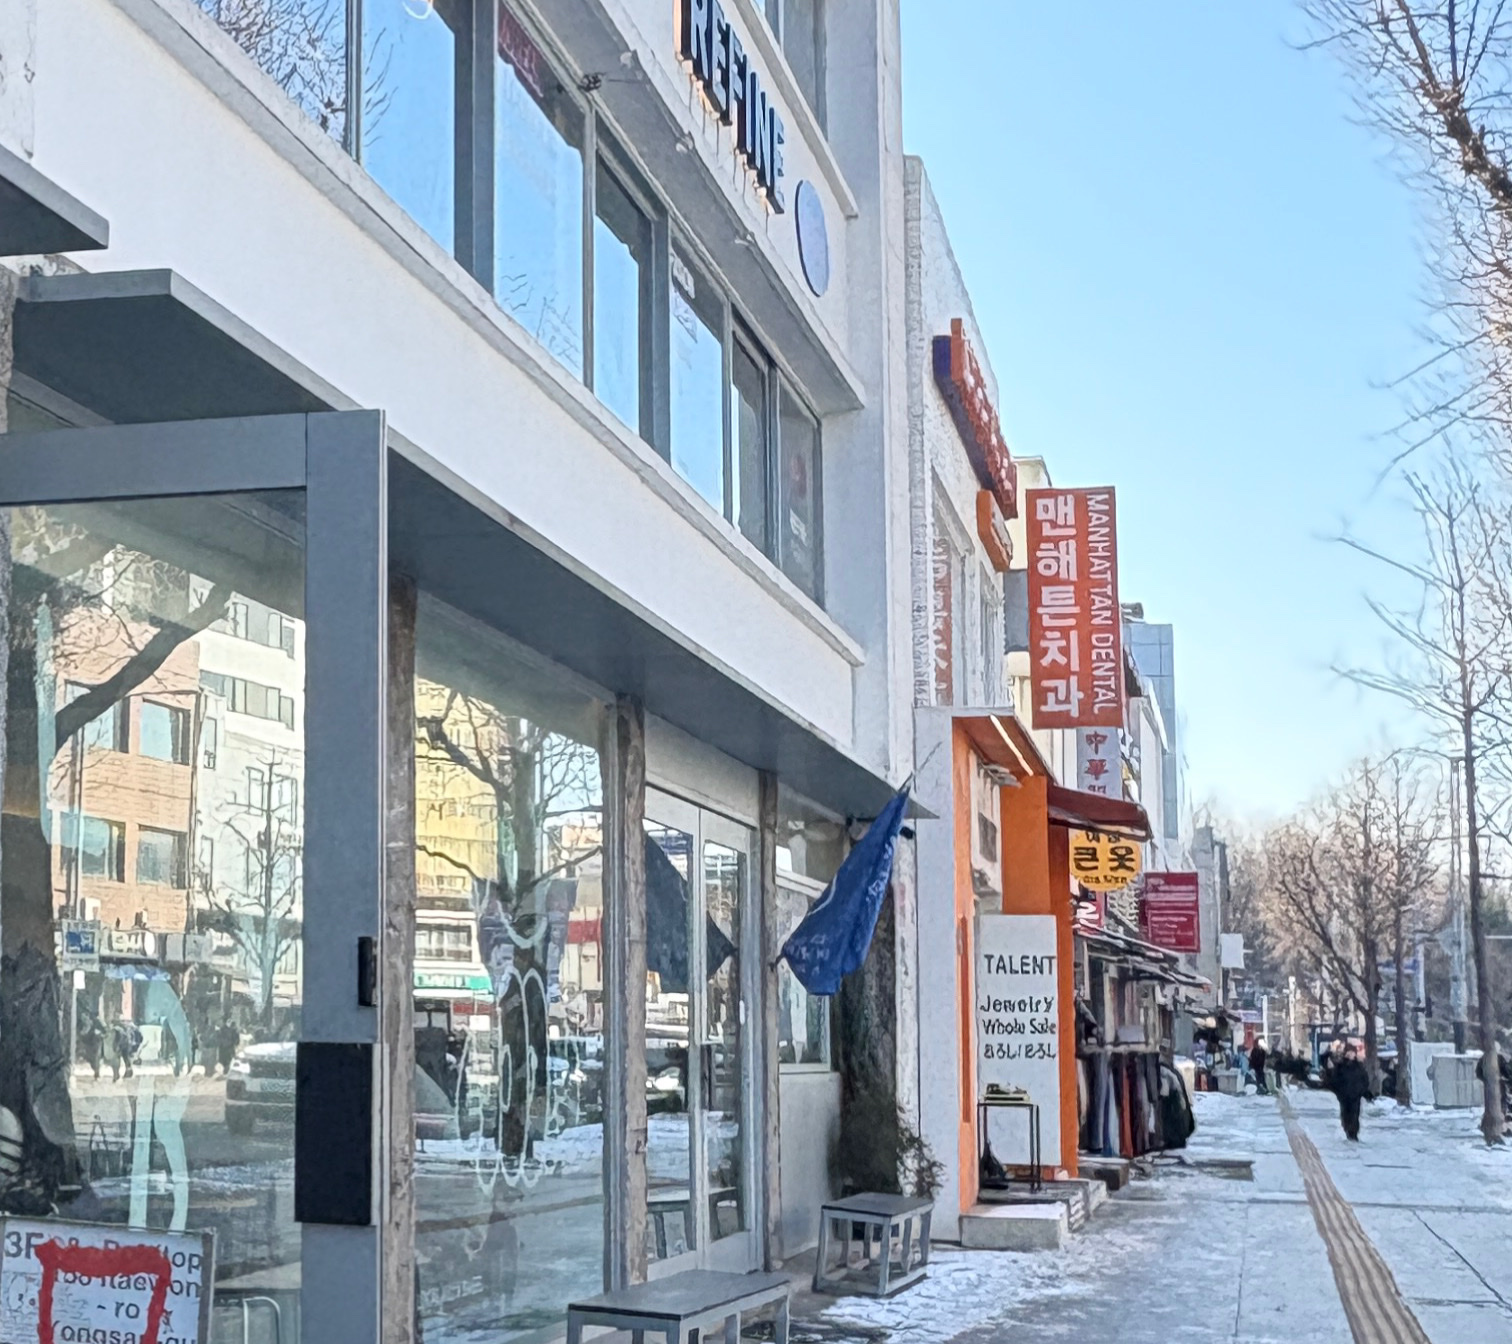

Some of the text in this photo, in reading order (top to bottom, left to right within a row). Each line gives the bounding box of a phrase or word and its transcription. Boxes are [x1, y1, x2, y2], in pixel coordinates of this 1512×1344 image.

[1034, 494, 1085, 719] 맨해튼치과
[1085, 493, 1119, 716] MANHATTAN DENTAL
[983, 953, 1057, 976] TALENT
[114, 1300, 141, 1320] ro
